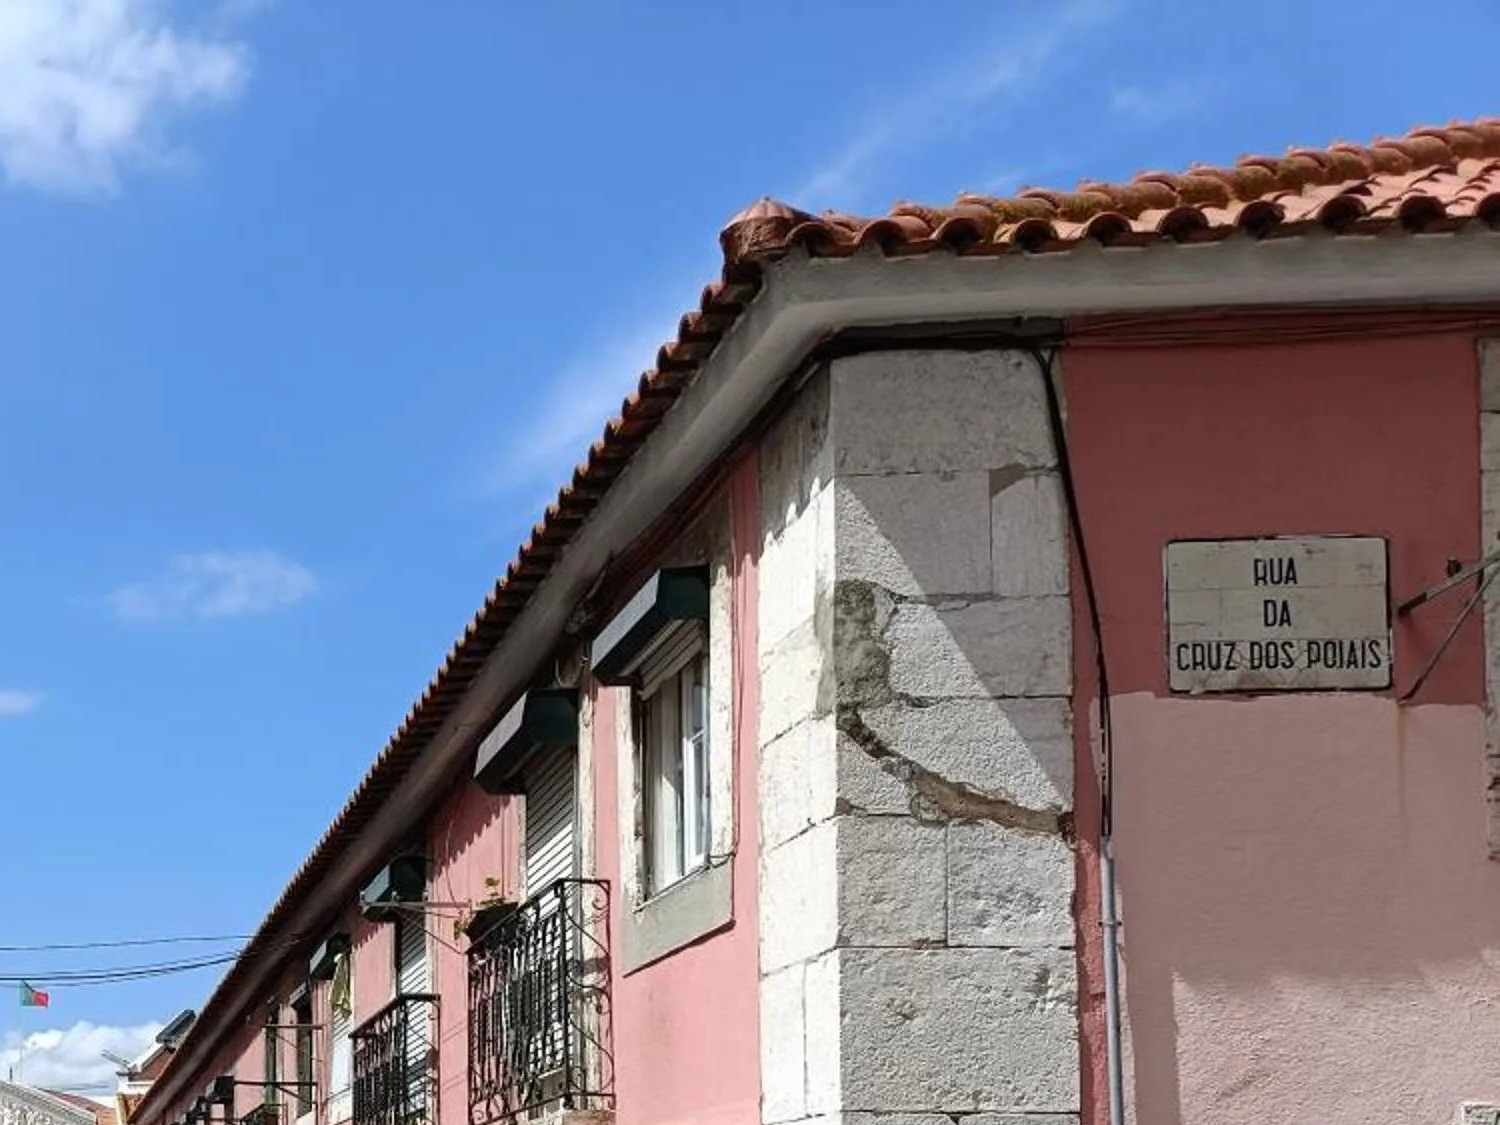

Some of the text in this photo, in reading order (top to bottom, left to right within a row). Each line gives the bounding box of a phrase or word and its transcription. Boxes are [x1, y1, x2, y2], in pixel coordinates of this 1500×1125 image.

[1253, 557, 1298, 586] RUA
[1263, 600, 1291, 627] DA
[1176, 639, 1382, 671] CRUZ DOS POIAIS
